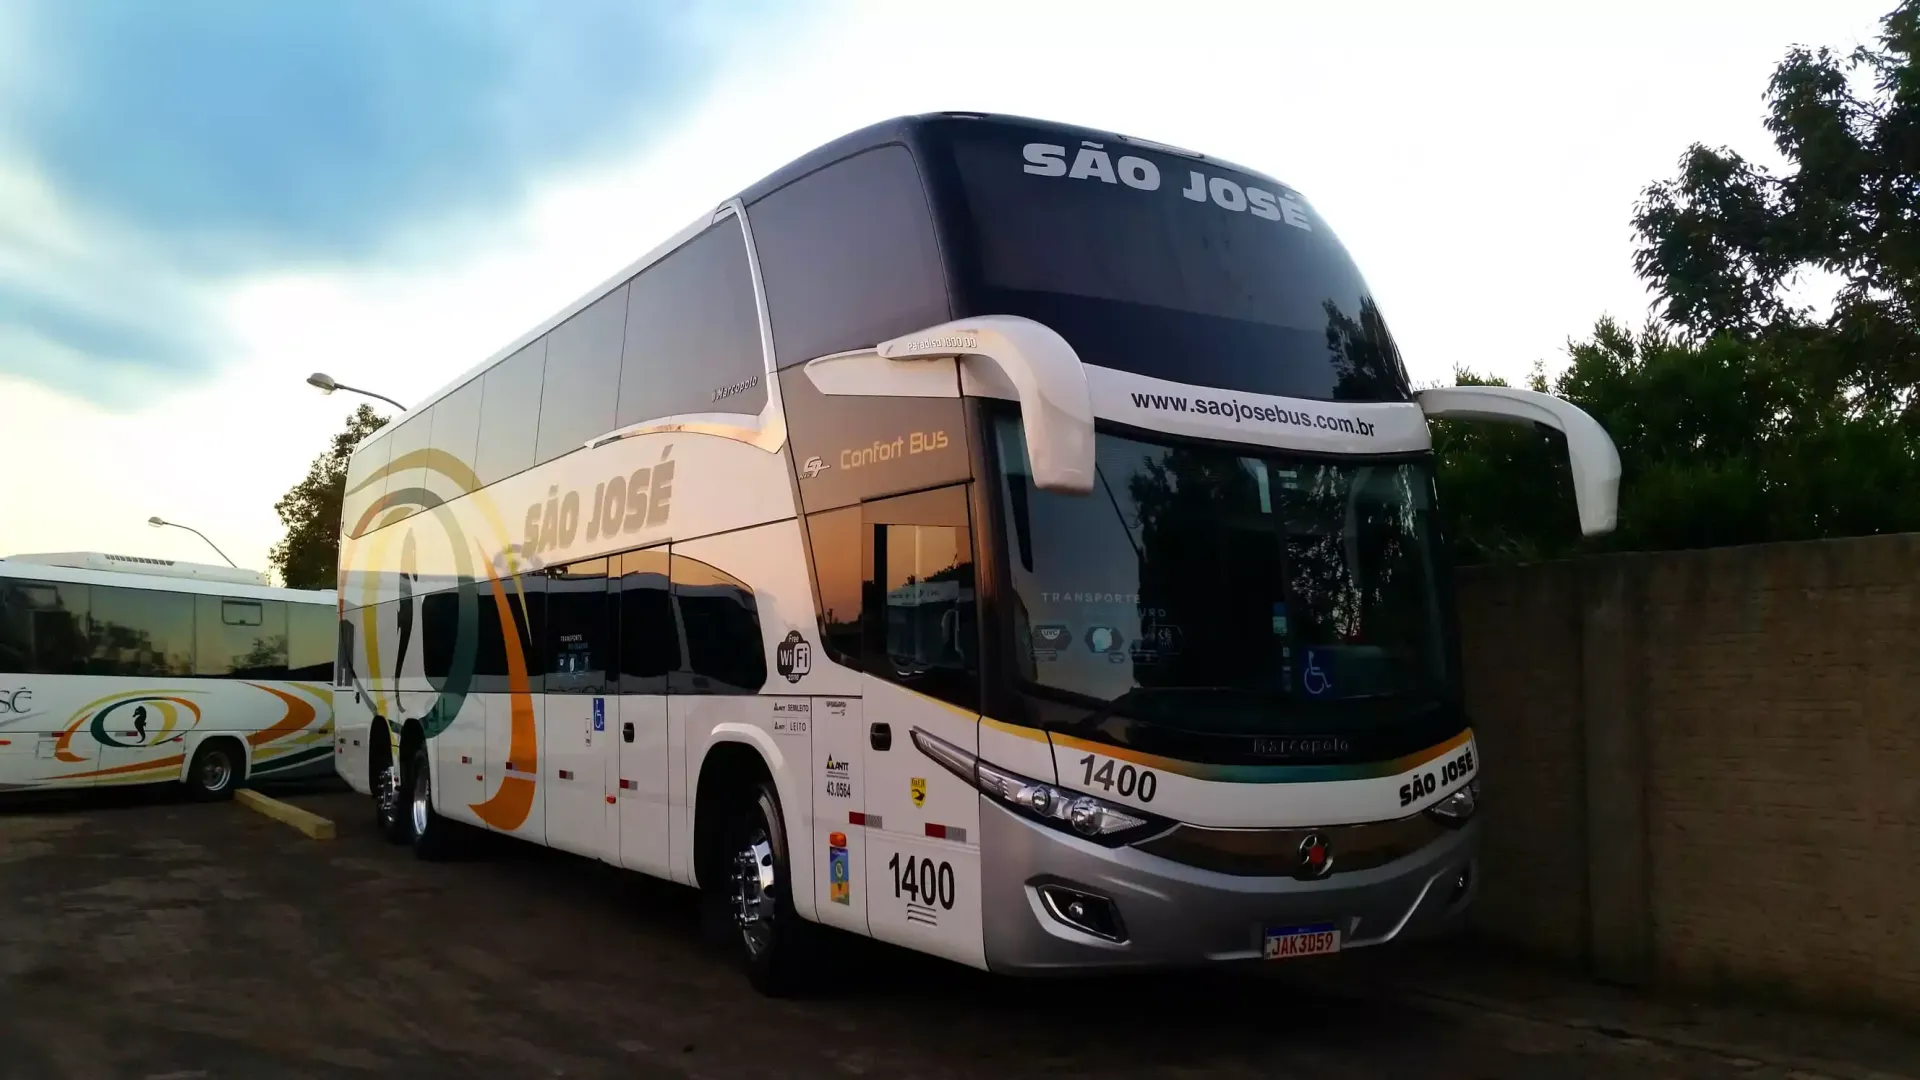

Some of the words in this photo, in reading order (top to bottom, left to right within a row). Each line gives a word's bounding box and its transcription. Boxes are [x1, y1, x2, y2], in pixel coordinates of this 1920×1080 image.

[1022, 141, 1161, 191] SÃO
[1183, 171, 1312, 232] JOSÉ
[907, 338, 943, 351] Paradiso
[716, 375, 759, 401] Marcopolo
[1131, 392, 1375, 437] www.saojosebus.com.br
[840, 435, 904, 471] Confort
[909, 430, 949, 454] Bus
[521, 484, 580, 558] SÃO
[586, 443, 675, 543] JOSÉ
[1041, 592, 1141, 604] TRANSPORTE
[788, 634, 800, 643] Free
[789, 722, 807, 732] LEITO
[1252, 737, 1350, 755] Marcopolo
[1080, 753, 1157, 803] 1400
[1399, 772, 1436, 807] SÃO
[1441, 746, 1474, 787] JOSÉ
[826, 781, 851, 799] 43.0564
[889, 852, 955, 911] 1400
[1271, 932, 1334, 955] JAK3D59
